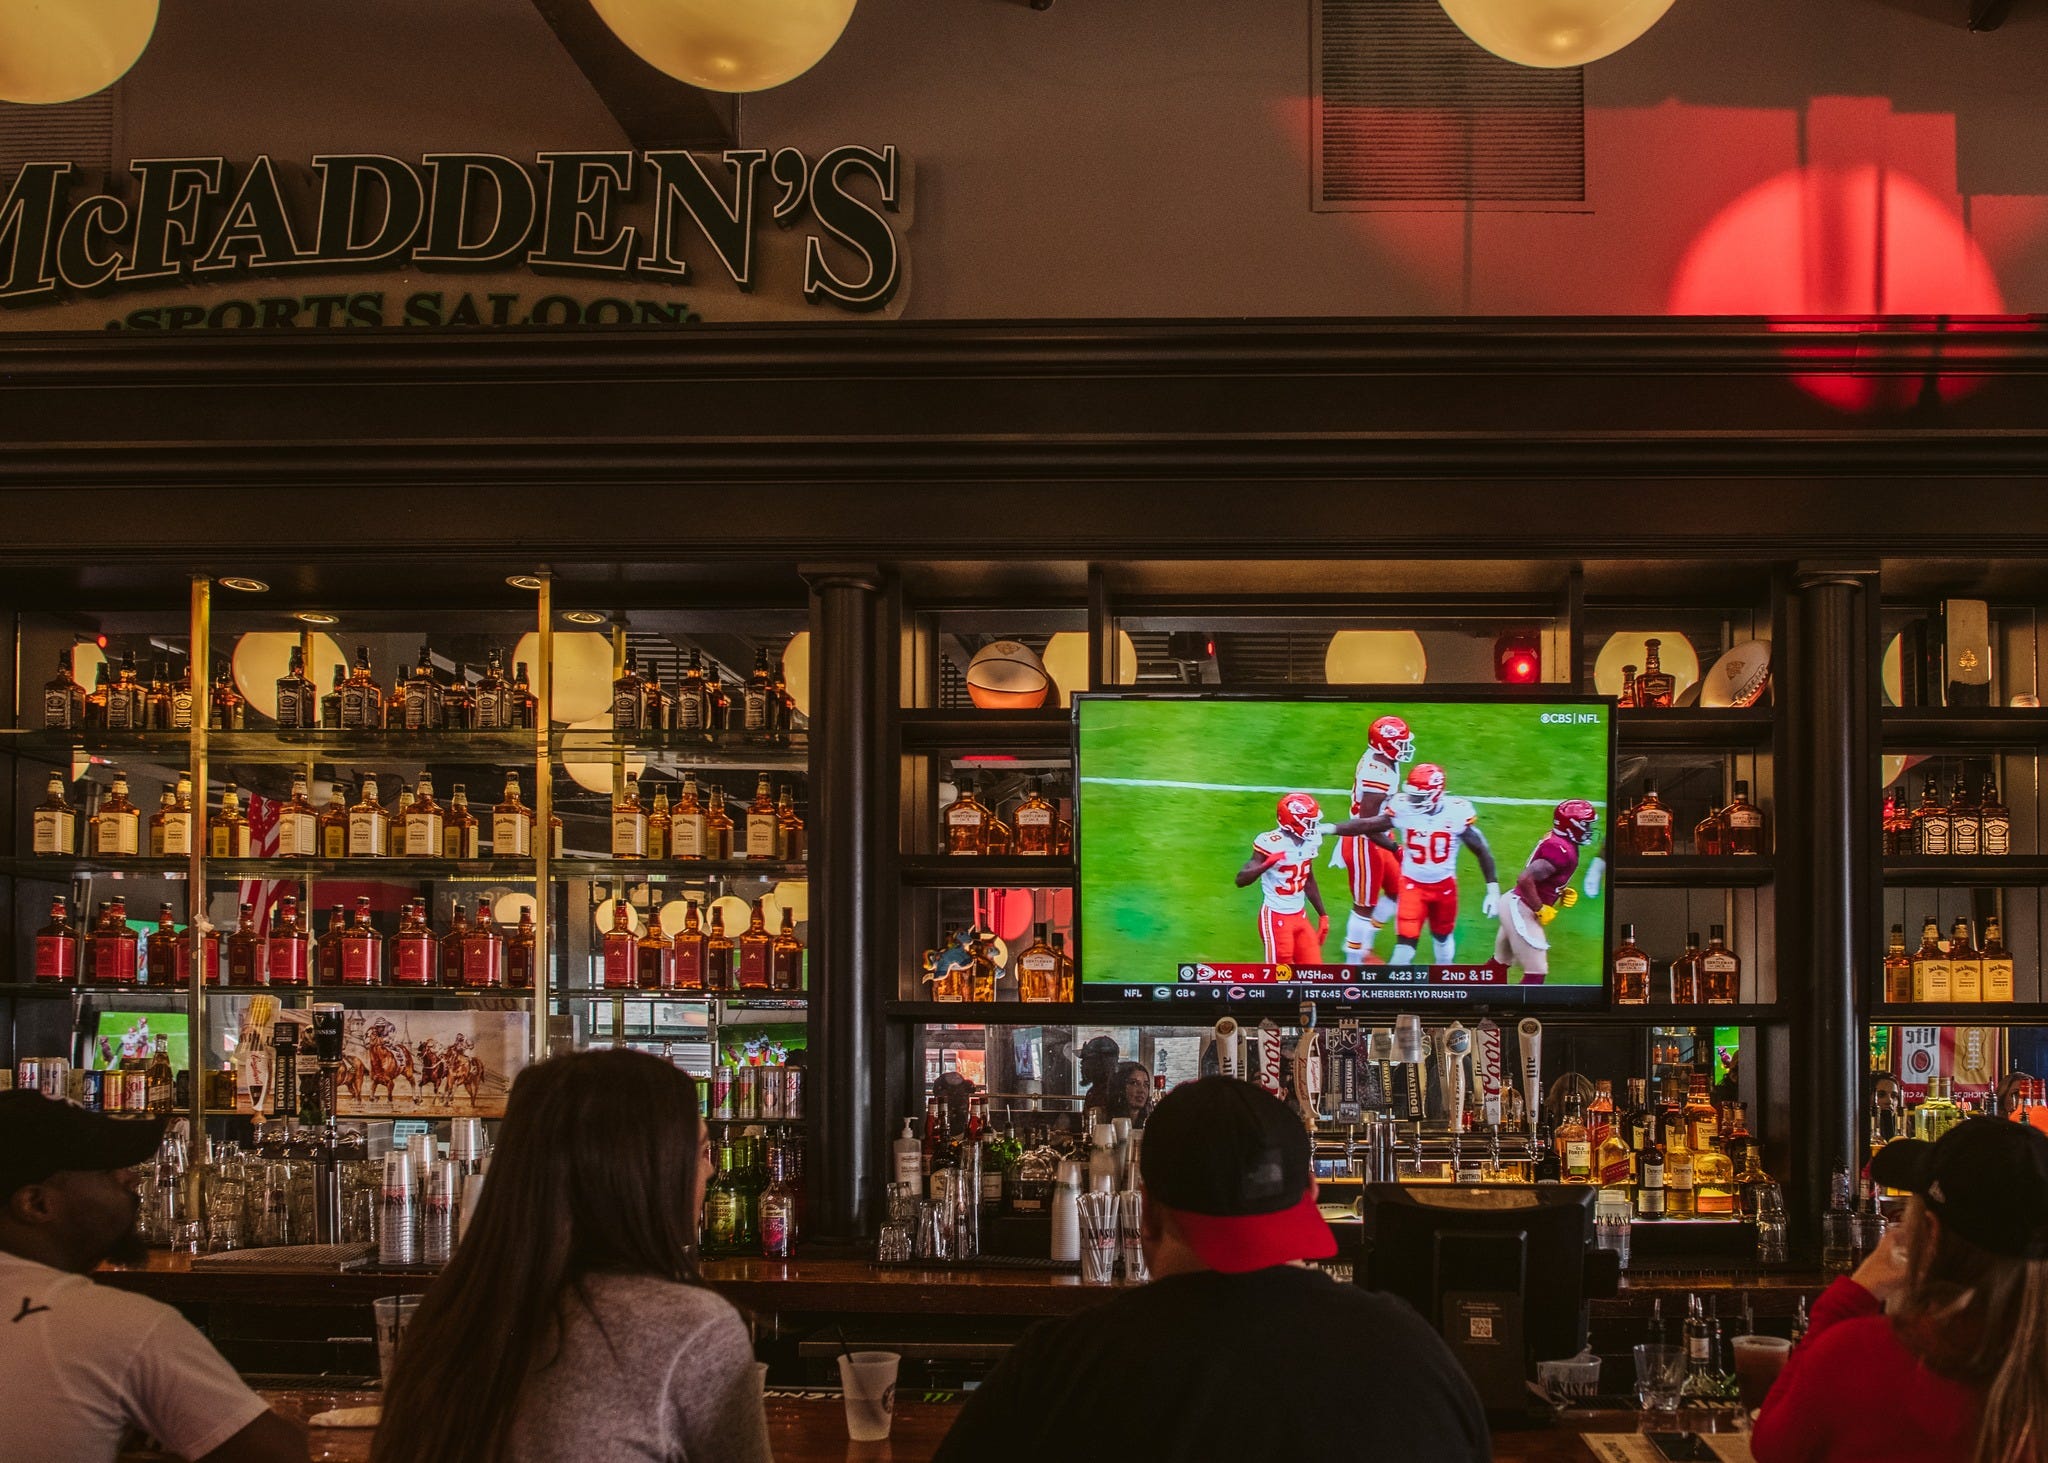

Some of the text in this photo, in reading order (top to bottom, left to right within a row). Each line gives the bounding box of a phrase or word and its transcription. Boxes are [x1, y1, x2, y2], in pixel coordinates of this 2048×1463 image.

[126, 292, 689, 329] SPORTS SALOON
[1550, 713, 1600, 724] CBS NFL
[1406, 828, 1449, 865] 50
[1217, 970, 1232, 979] KC
[1262, 969, 1271, 979] 7
[1296, 970, 1321, 979] WSH
[1341, 969, 1350, 980] 0
[1361, 970, 1428, 980] 1ST 4:23 37
[1442, 970, 1494, 980] 2ND & 15
[1124, 989, 1142, 997] NFL
[1212, 989, 1220, 998] 0
[1248, 989, 1294, 998] CHI 7
[1305, 989, 1341, 998] 1ST 6:45
[1361, 990, 1370, 998] K.
[1431, 990, 1454, 998] RUSH
[1455, 990, 1467, 998] TD
[1260, 1028, 1280, 1095] Coors
[1483, 1028, 1499, 1096] Coors
[1526, 1057, 1538, 1078] Lite
[277, 1057, 285, 1108] BOULEVARD
